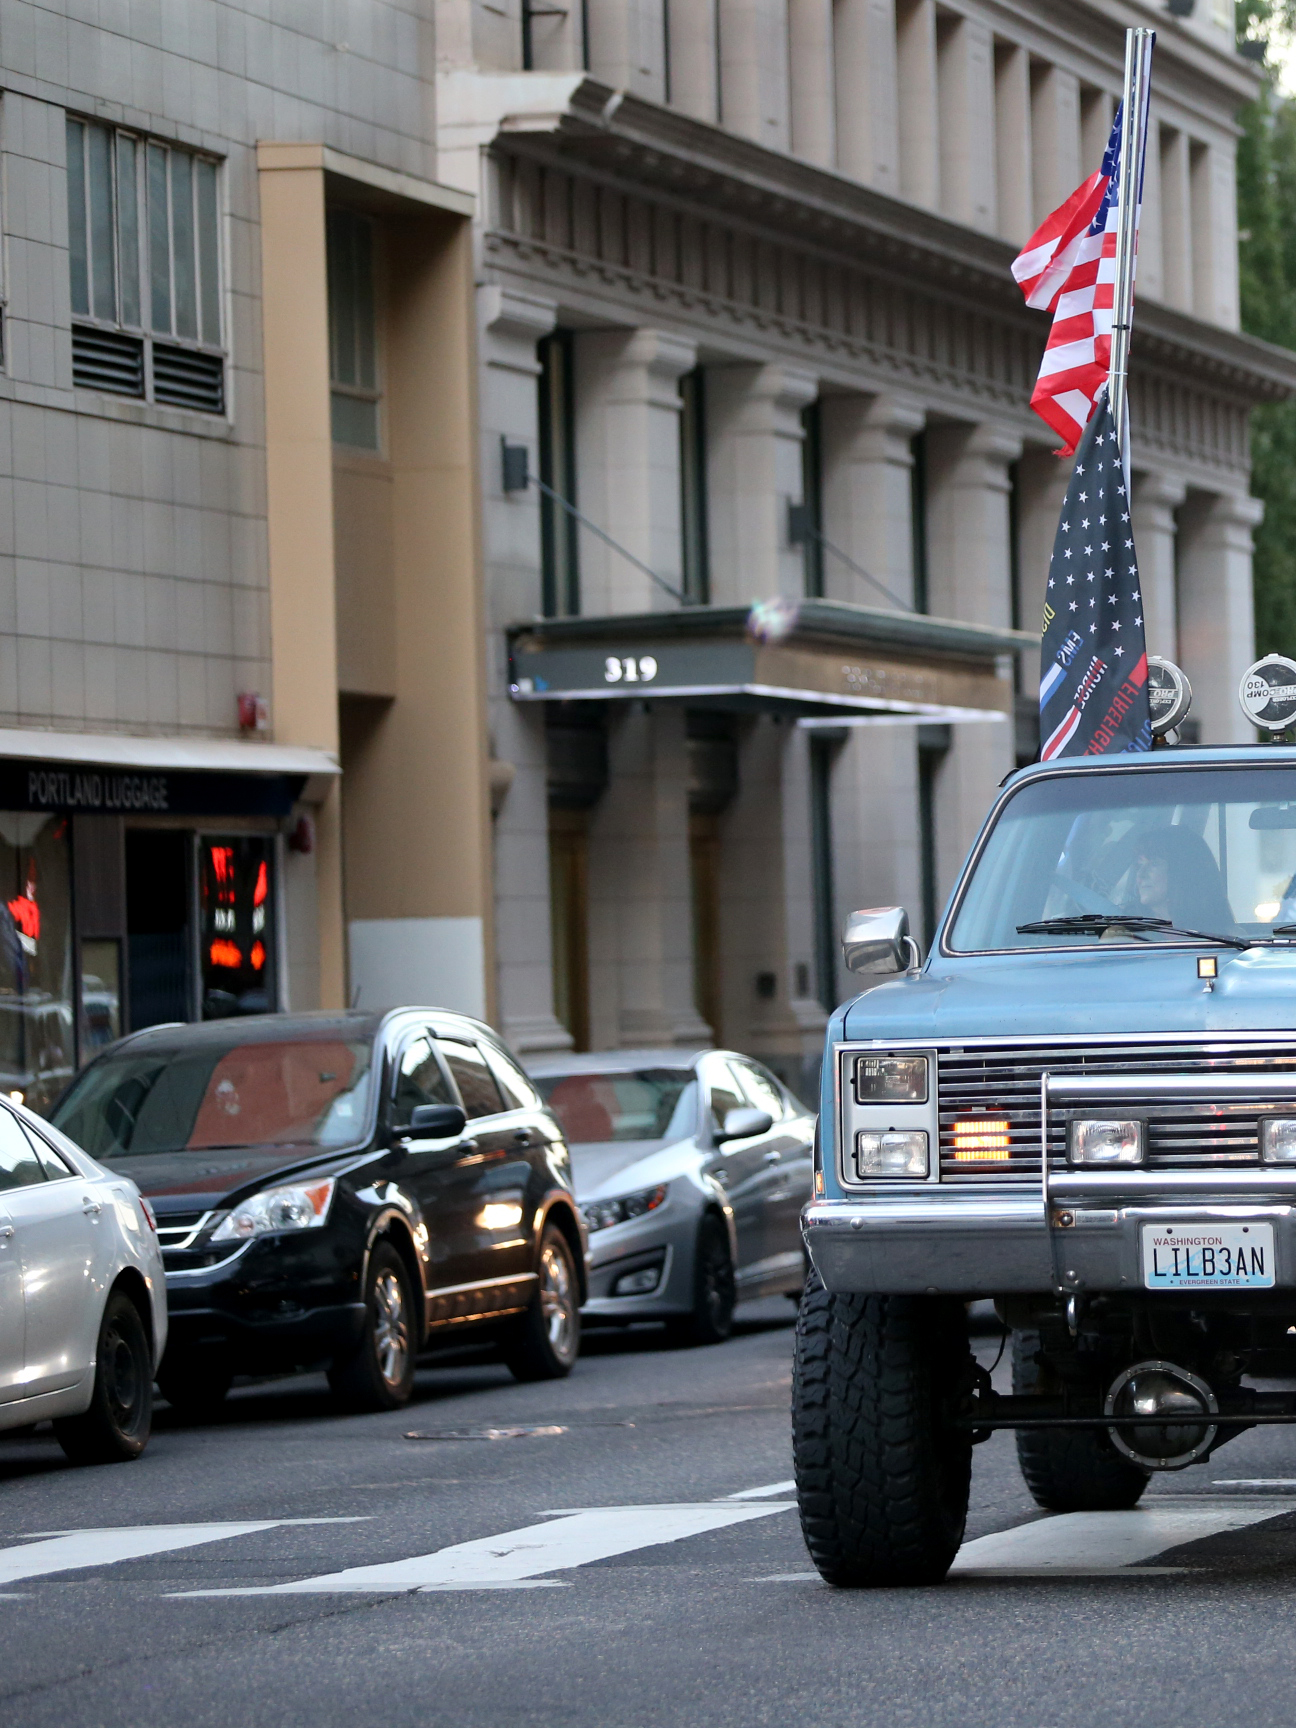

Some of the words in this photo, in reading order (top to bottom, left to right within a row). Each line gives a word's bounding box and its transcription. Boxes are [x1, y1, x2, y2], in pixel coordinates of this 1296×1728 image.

[604, 655, 658, 683] 319
[1247, 681, 1264, 689] 130
[1153, 690, 1175, 698] PRO
[1246, 689, 1275, 698] COMP
[28, 771, 101, 807] PORTLAND
[104, 775, 169, 809] LUGGAGE
[1153, 1237, 1222, 1246] WASHINGTON
[1153, 1246, 1265, 1277] LILB3AN
